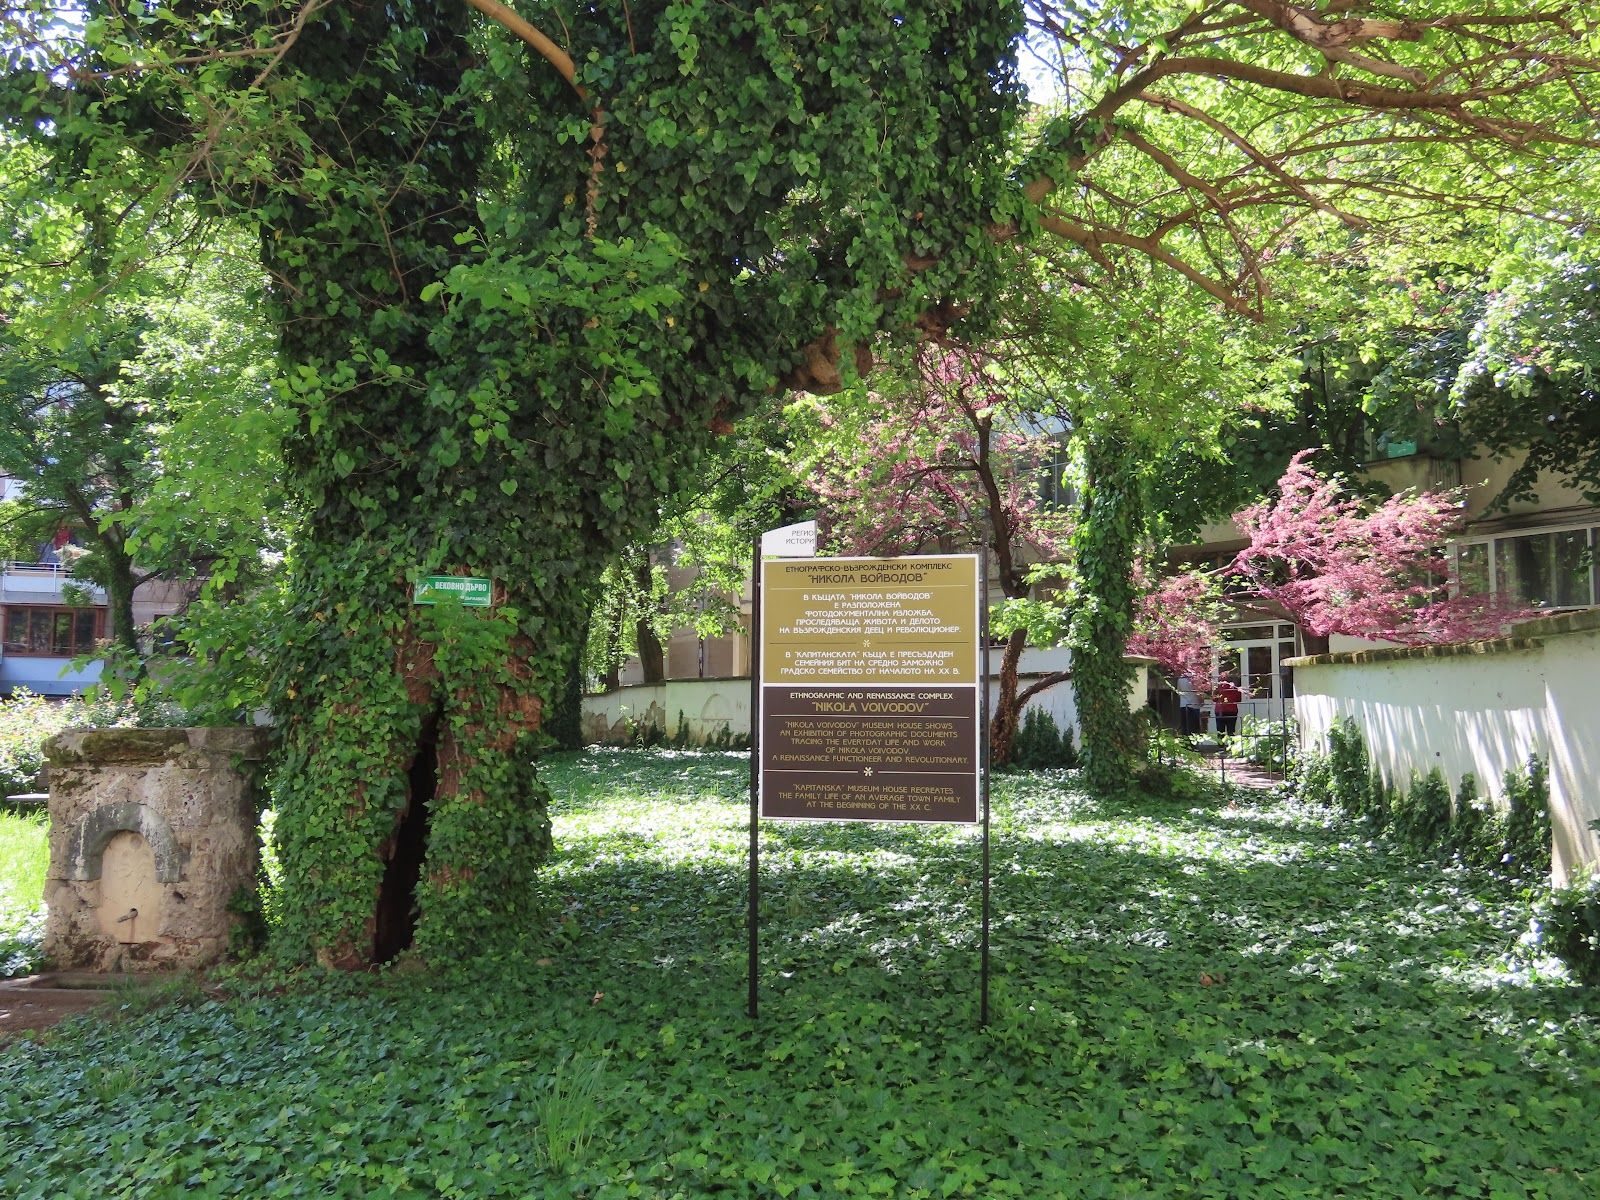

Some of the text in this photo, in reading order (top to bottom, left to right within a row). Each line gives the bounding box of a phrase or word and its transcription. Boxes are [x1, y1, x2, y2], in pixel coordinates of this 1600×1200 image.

[786, 564, 907, 572] ЕТНОГРАФСКО-ВЪЗРОЖДЕНСКИ
[808, 573, 927, 584] "НИКОЛА ВОЙВОДОВ"
[435, 582, 487, 591] ВЕКОВНО ДЪРВО
[886, 592, 933, 600] ВОЙВОДОВ"
[796, 618, 859, 626] ПРОСЛЕДЯВАЩА
[896, 626, 961, 634] РЕВОЛЮЦИОНЕР.
[818, 667, 862, 675] СЕМЕЙСТВО
[812, 702, 929, 712] "NIKOLA VOIVODOV"
[868, 794, 905, 802] AVERAGE
